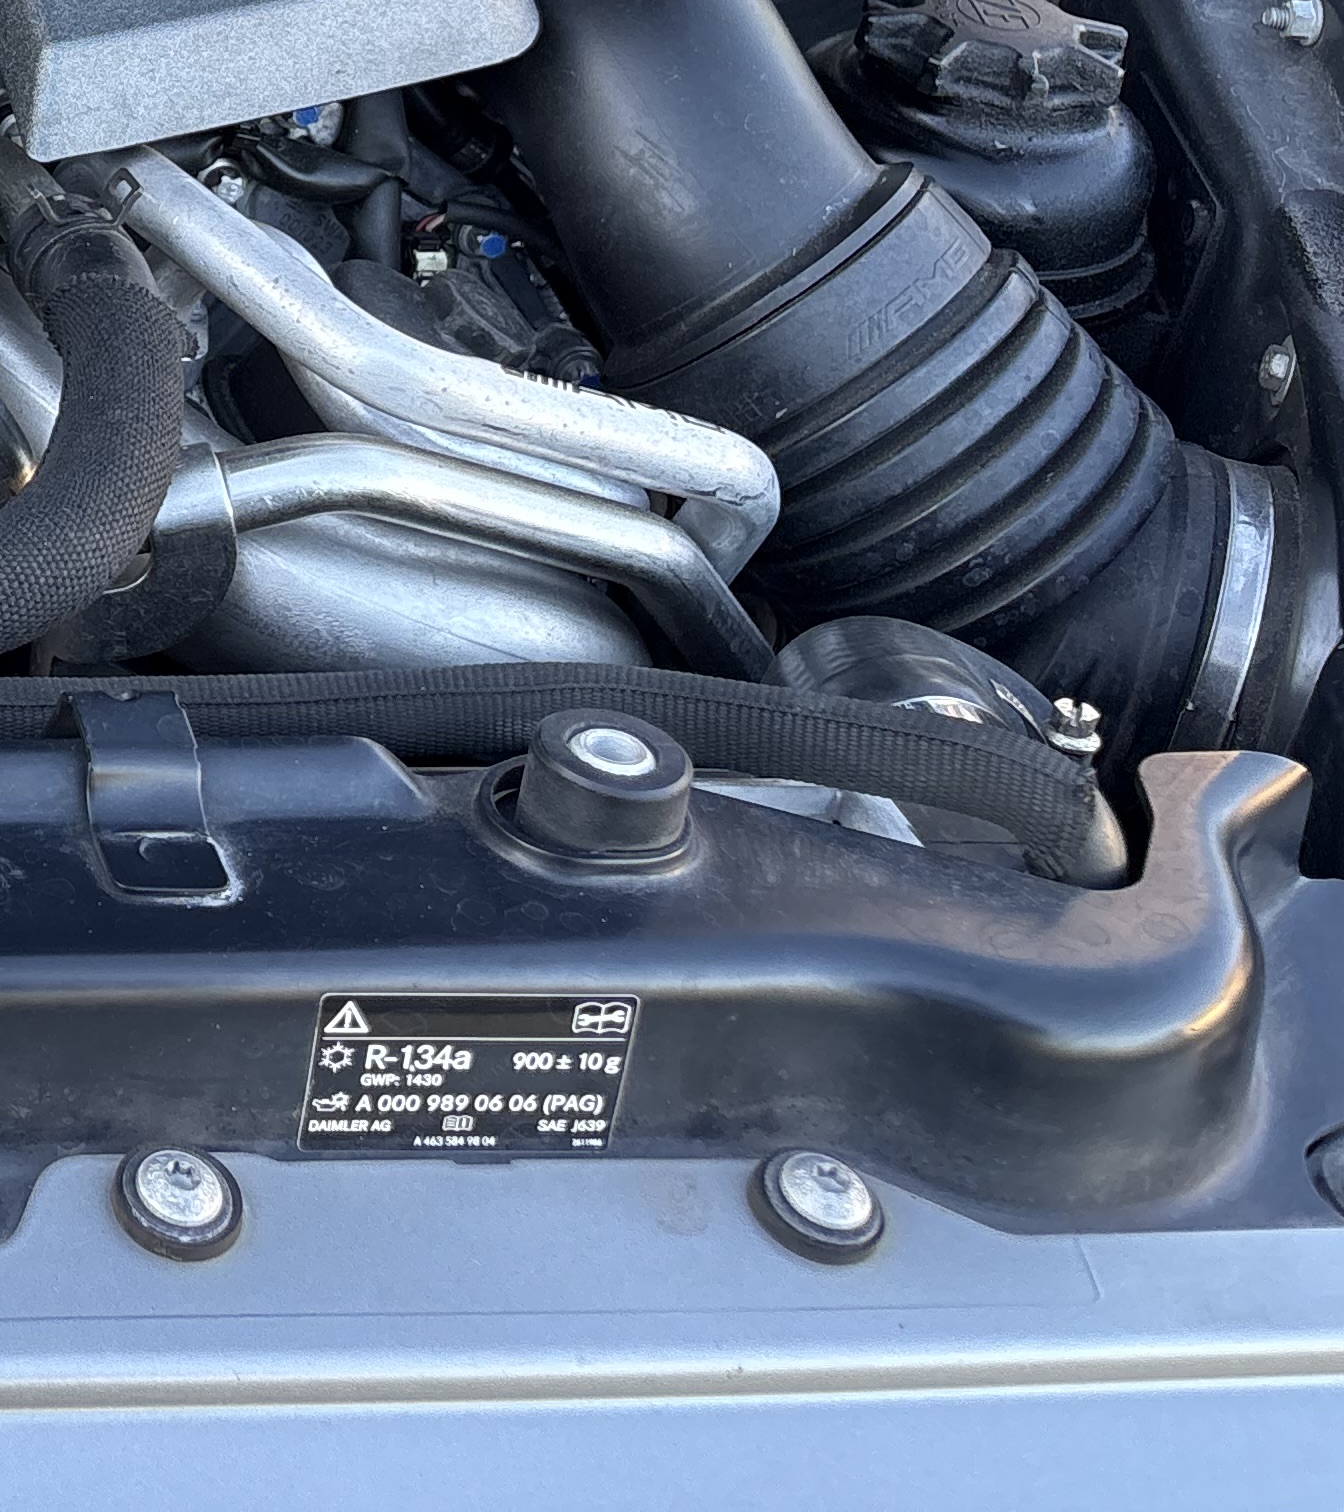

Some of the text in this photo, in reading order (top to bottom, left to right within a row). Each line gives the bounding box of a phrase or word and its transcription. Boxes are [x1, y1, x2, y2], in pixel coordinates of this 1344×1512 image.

[364, 1044, 473, 1071] R-134a
[513, 1052, 554, 1070] 900
[578, 1052, 601, 1070] 10
[603, 1055, 622, 1075] g
[360, 1073, 443, 1087] GWP: 1430
[354, 1094, 604, 1115] A 000 989 06 06 (PAG)
[308, 1119, 392, 1132] DAIMLER AG
[537, 1119, 607, 1133] SAE J639
